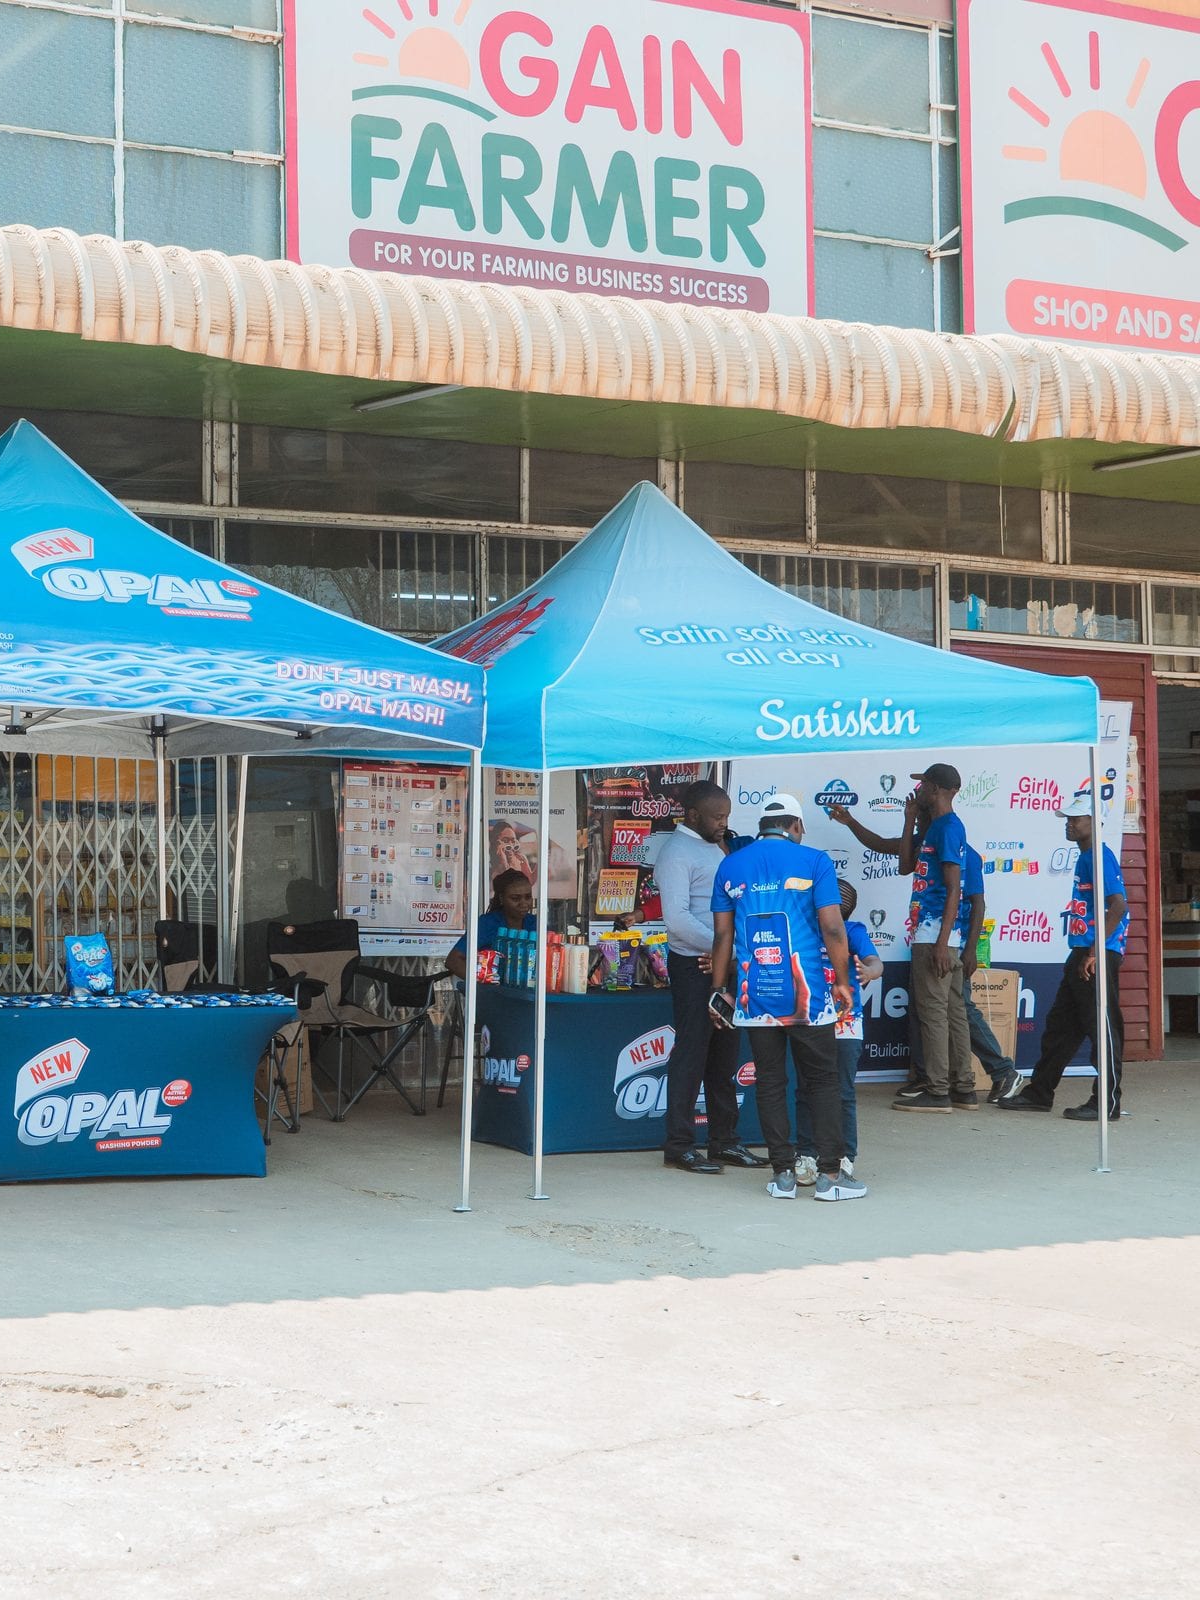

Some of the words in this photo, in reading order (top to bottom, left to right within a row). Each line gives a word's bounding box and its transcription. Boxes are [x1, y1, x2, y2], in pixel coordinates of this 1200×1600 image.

[479, 11, 744, 147] GAIN
[351, 113, 767, 268] FARMER
[374, 241, 413, 266] FOR
[419, 247, 476, 272] YOUR
[481, 253, 570, 284] FARMING
[575, 263, 664, 294] BUSINESS
[669, 276, 748, 305] SUCCESS
[1033, 295, 1108, 332] SHOP
[1115, 306, 1172, 339] AND
[25, 536, 82, 558] NEW
[42, 566, 253, 612] OPAL
[640, 625, 728, 646] Satin
[736, 622, 792, 645] soft
[797, 626, 873, 649] skin,
[726, 646, 773, 666] all
[777, 647, 842, 669] day
[276, 661, 345, 683] DON'T
[349, 667, 406, 690] JUST
[410, 675, 473, 704] WASH,
[319, 691, 376, 715] OPAL
[381, 698, 446, 726] WASH!
[756, 697, 921, 742] Satiskin
[1019, 776, 1047, 793] Girl
[631, 800, 670, 817] US$10
[868, 797, 885, 808] JABU
[886, 797, 906, 807] STONE
[1009, 792, 1062, 811] Friend
[614, 830, 640, 844] 107x
[986, 841, 997, 850] TOP
[998, 841, 1019, 850] SOCIETY
[611, 854, 646, 862] FREEZERS
[631, 845, 650, 853] DEEP
[881, 860, 890, 868] to
[600, 887, 623, 896] WHEEL
[625, 887, 635, 896] TO
[602, 880, 618, 888] SPIN
[621, 880, 634, 888] THE
[598, 897, 633, 913] WIN!!
[1008, 909, 1037, 927] Girl
[999, 925, 1051, 943] Friend
[629, 1036, 666, 1065] NEW
[30, 1051, 72, 1084] NEW
[484, 1057, 520, 1087] OPAL
[17, 1087, 172, 1146] OPAL
[99, 1141, 131, 1150] WASHING
[132, 1139, 159, 1148] POWDER
